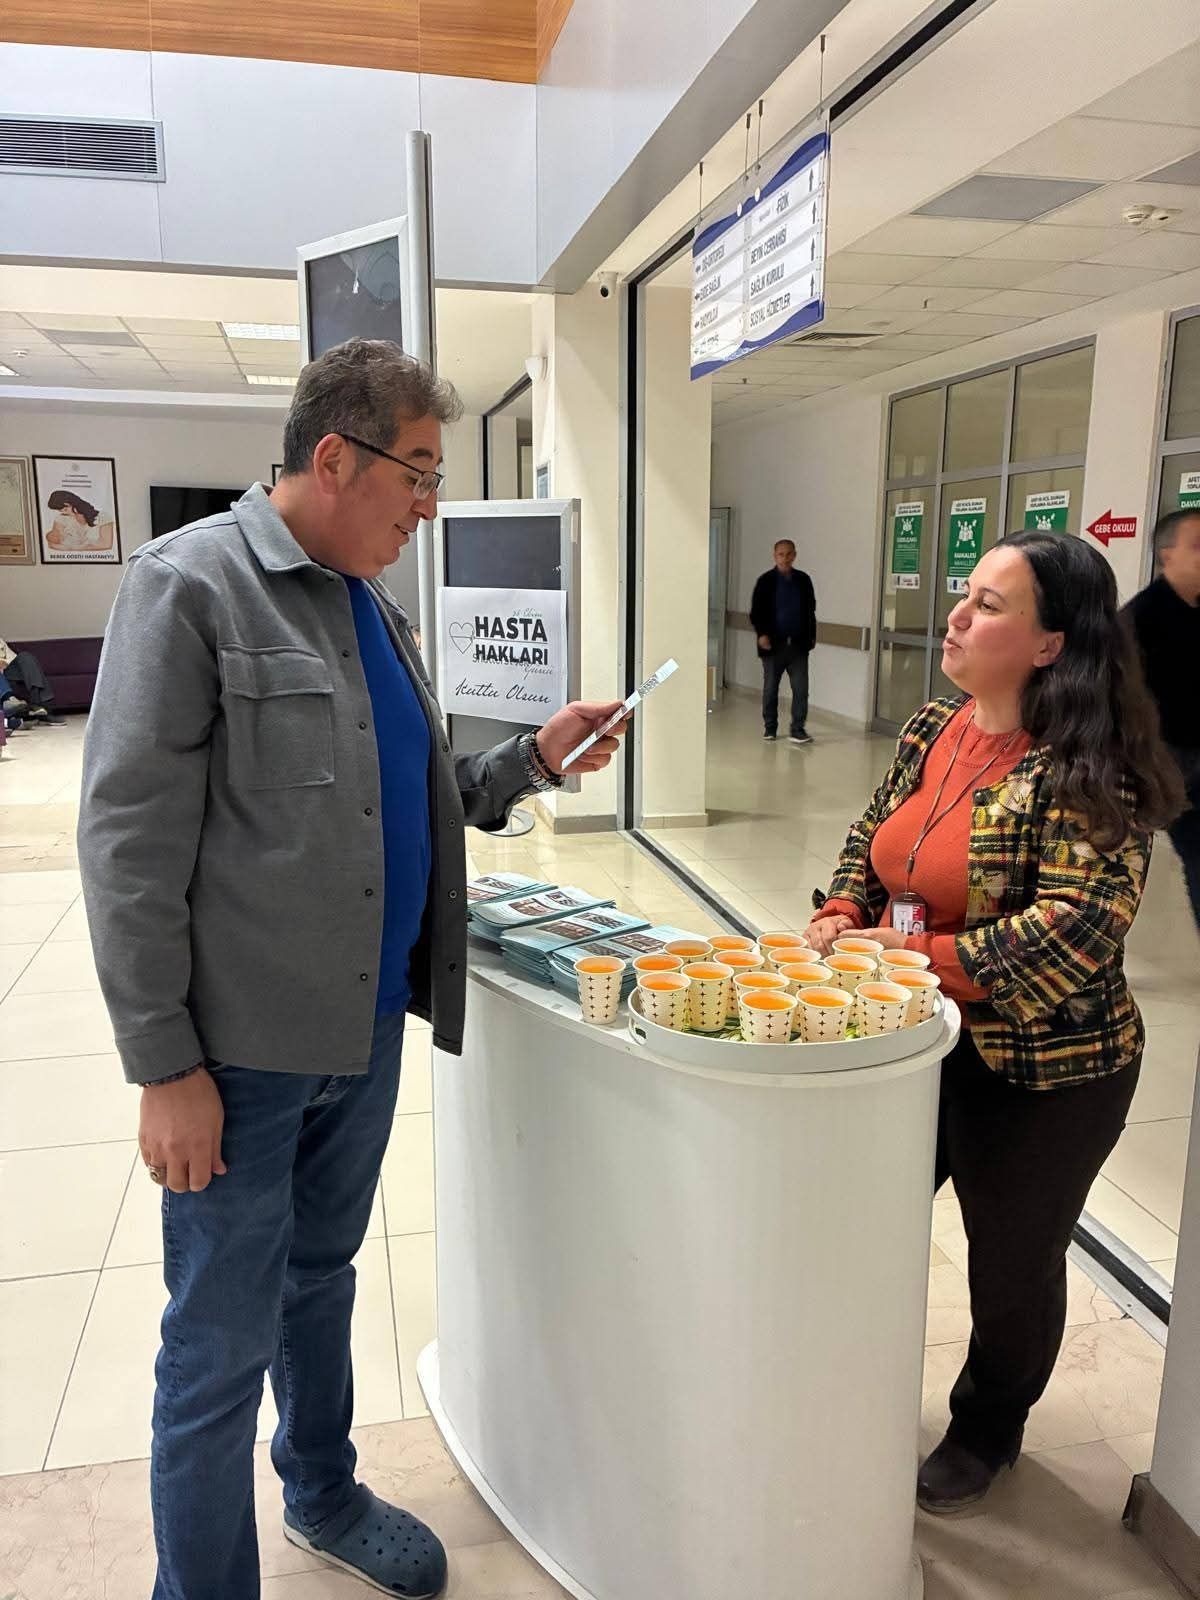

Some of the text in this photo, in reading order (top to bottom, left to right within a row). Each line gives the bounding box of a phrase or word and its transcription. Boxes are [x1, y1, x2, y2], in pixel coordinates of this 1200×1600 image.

[750, 262, 785, 297] SAĞLIK KURULU
[766, 292, 791, 318] HİZMETLER
[1094, 522, 1135, 533] GEBE OKULU
[475, 616, 547, 642] HASTA
[475, 644, 549, 666] HAKLARI
[505, 684, 552, 704] Olsun
